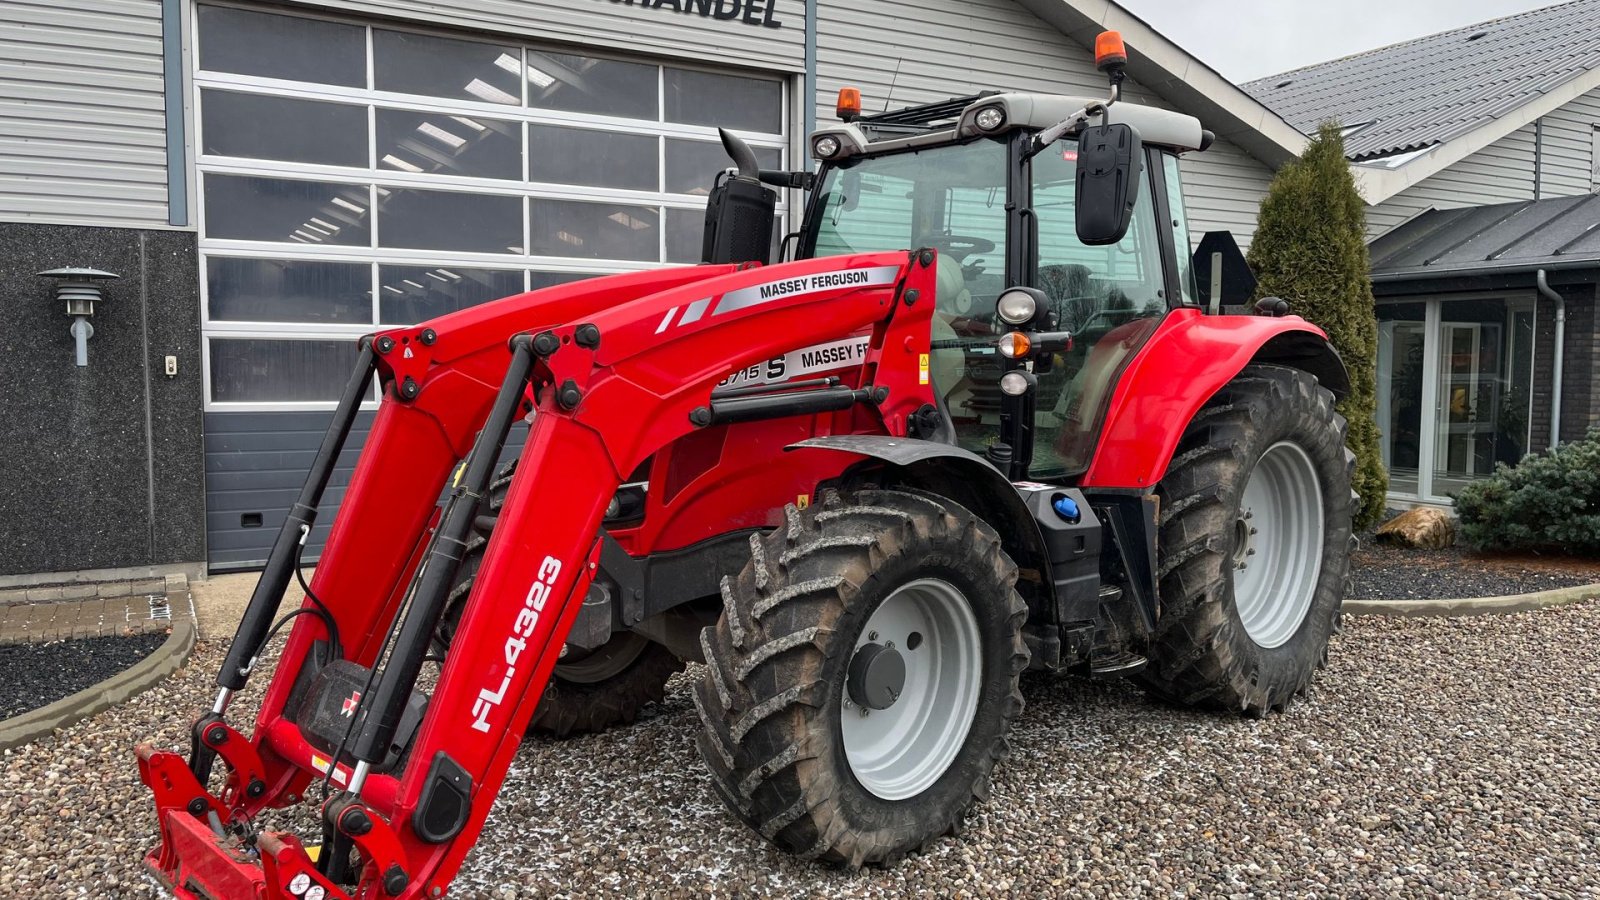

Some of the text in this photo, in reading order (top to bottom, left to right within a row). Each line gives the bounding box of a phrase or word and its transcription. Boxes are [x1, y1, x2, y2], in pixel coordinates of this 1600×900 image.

[760, 271, 868, 299] MASSEY FERGUSON
[767, 354, 786, 379] S
[801, 345, 852, 368] MASSEY
[471, 555, 562, 733] FL.4323
